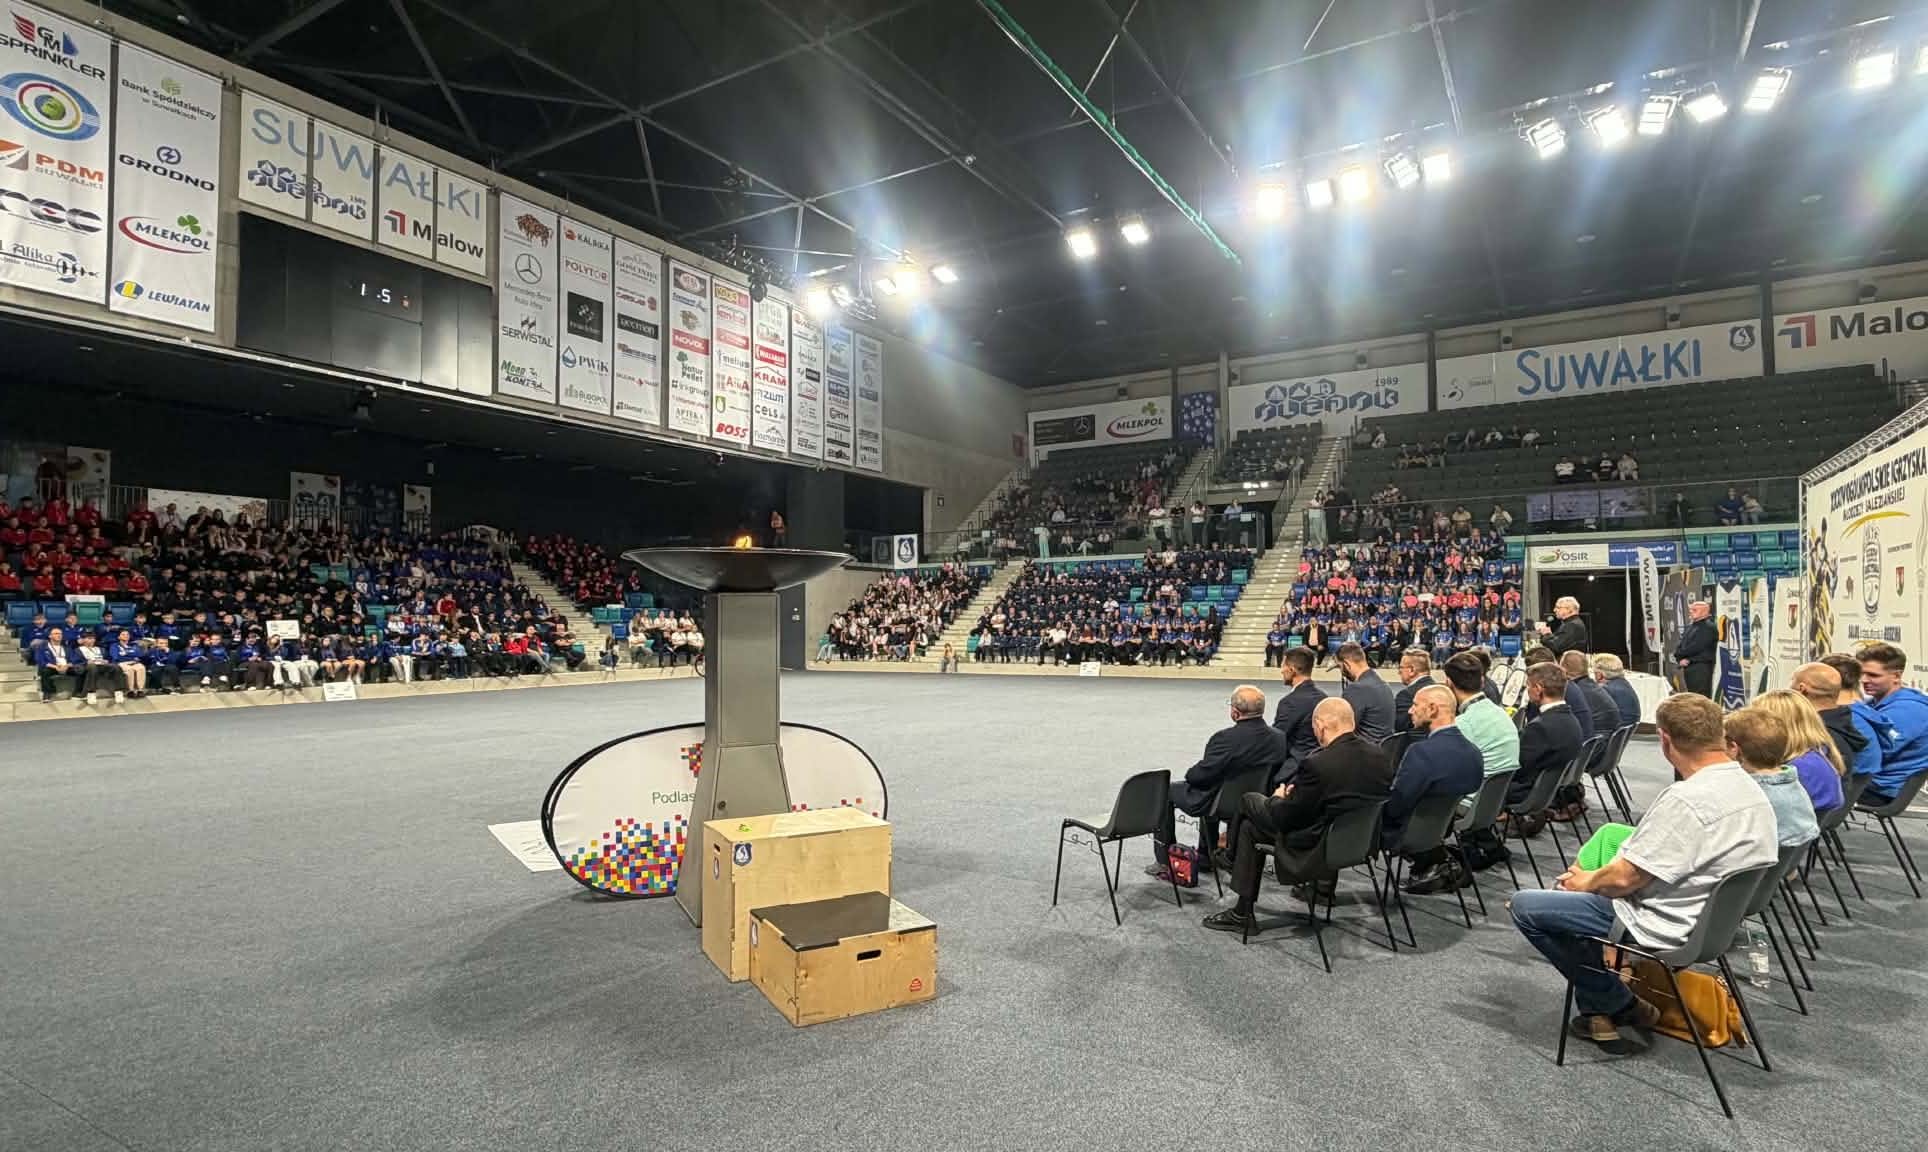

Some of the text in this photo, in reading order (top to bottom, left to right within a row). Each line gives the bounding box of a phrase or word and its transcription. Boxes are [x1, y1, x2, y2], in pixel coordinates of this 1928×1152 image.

[0, 33, 106, 81] SPRINKLER
[121, 79, 150, 96] Bank
[36, 153, 104, 182] PDM
[119, 153, 216, 192] GRODNO
[251, 108, 480, 220] SUWAŁKI
[135, 221, 211, 251] MLEKPOL
[412, 219, 484, 259] Malow
[148, 290, 211, 313] LEWIATAN
[501, 325, 553, 348] SERWISTAL
[1516, 339, 1702, 397] SUWAŁKI
[715, 422, 748, 438] BOSS
[1116, 416, 1164, 432] MLEKPOL
[652, 790, 697, 805] Podlas
